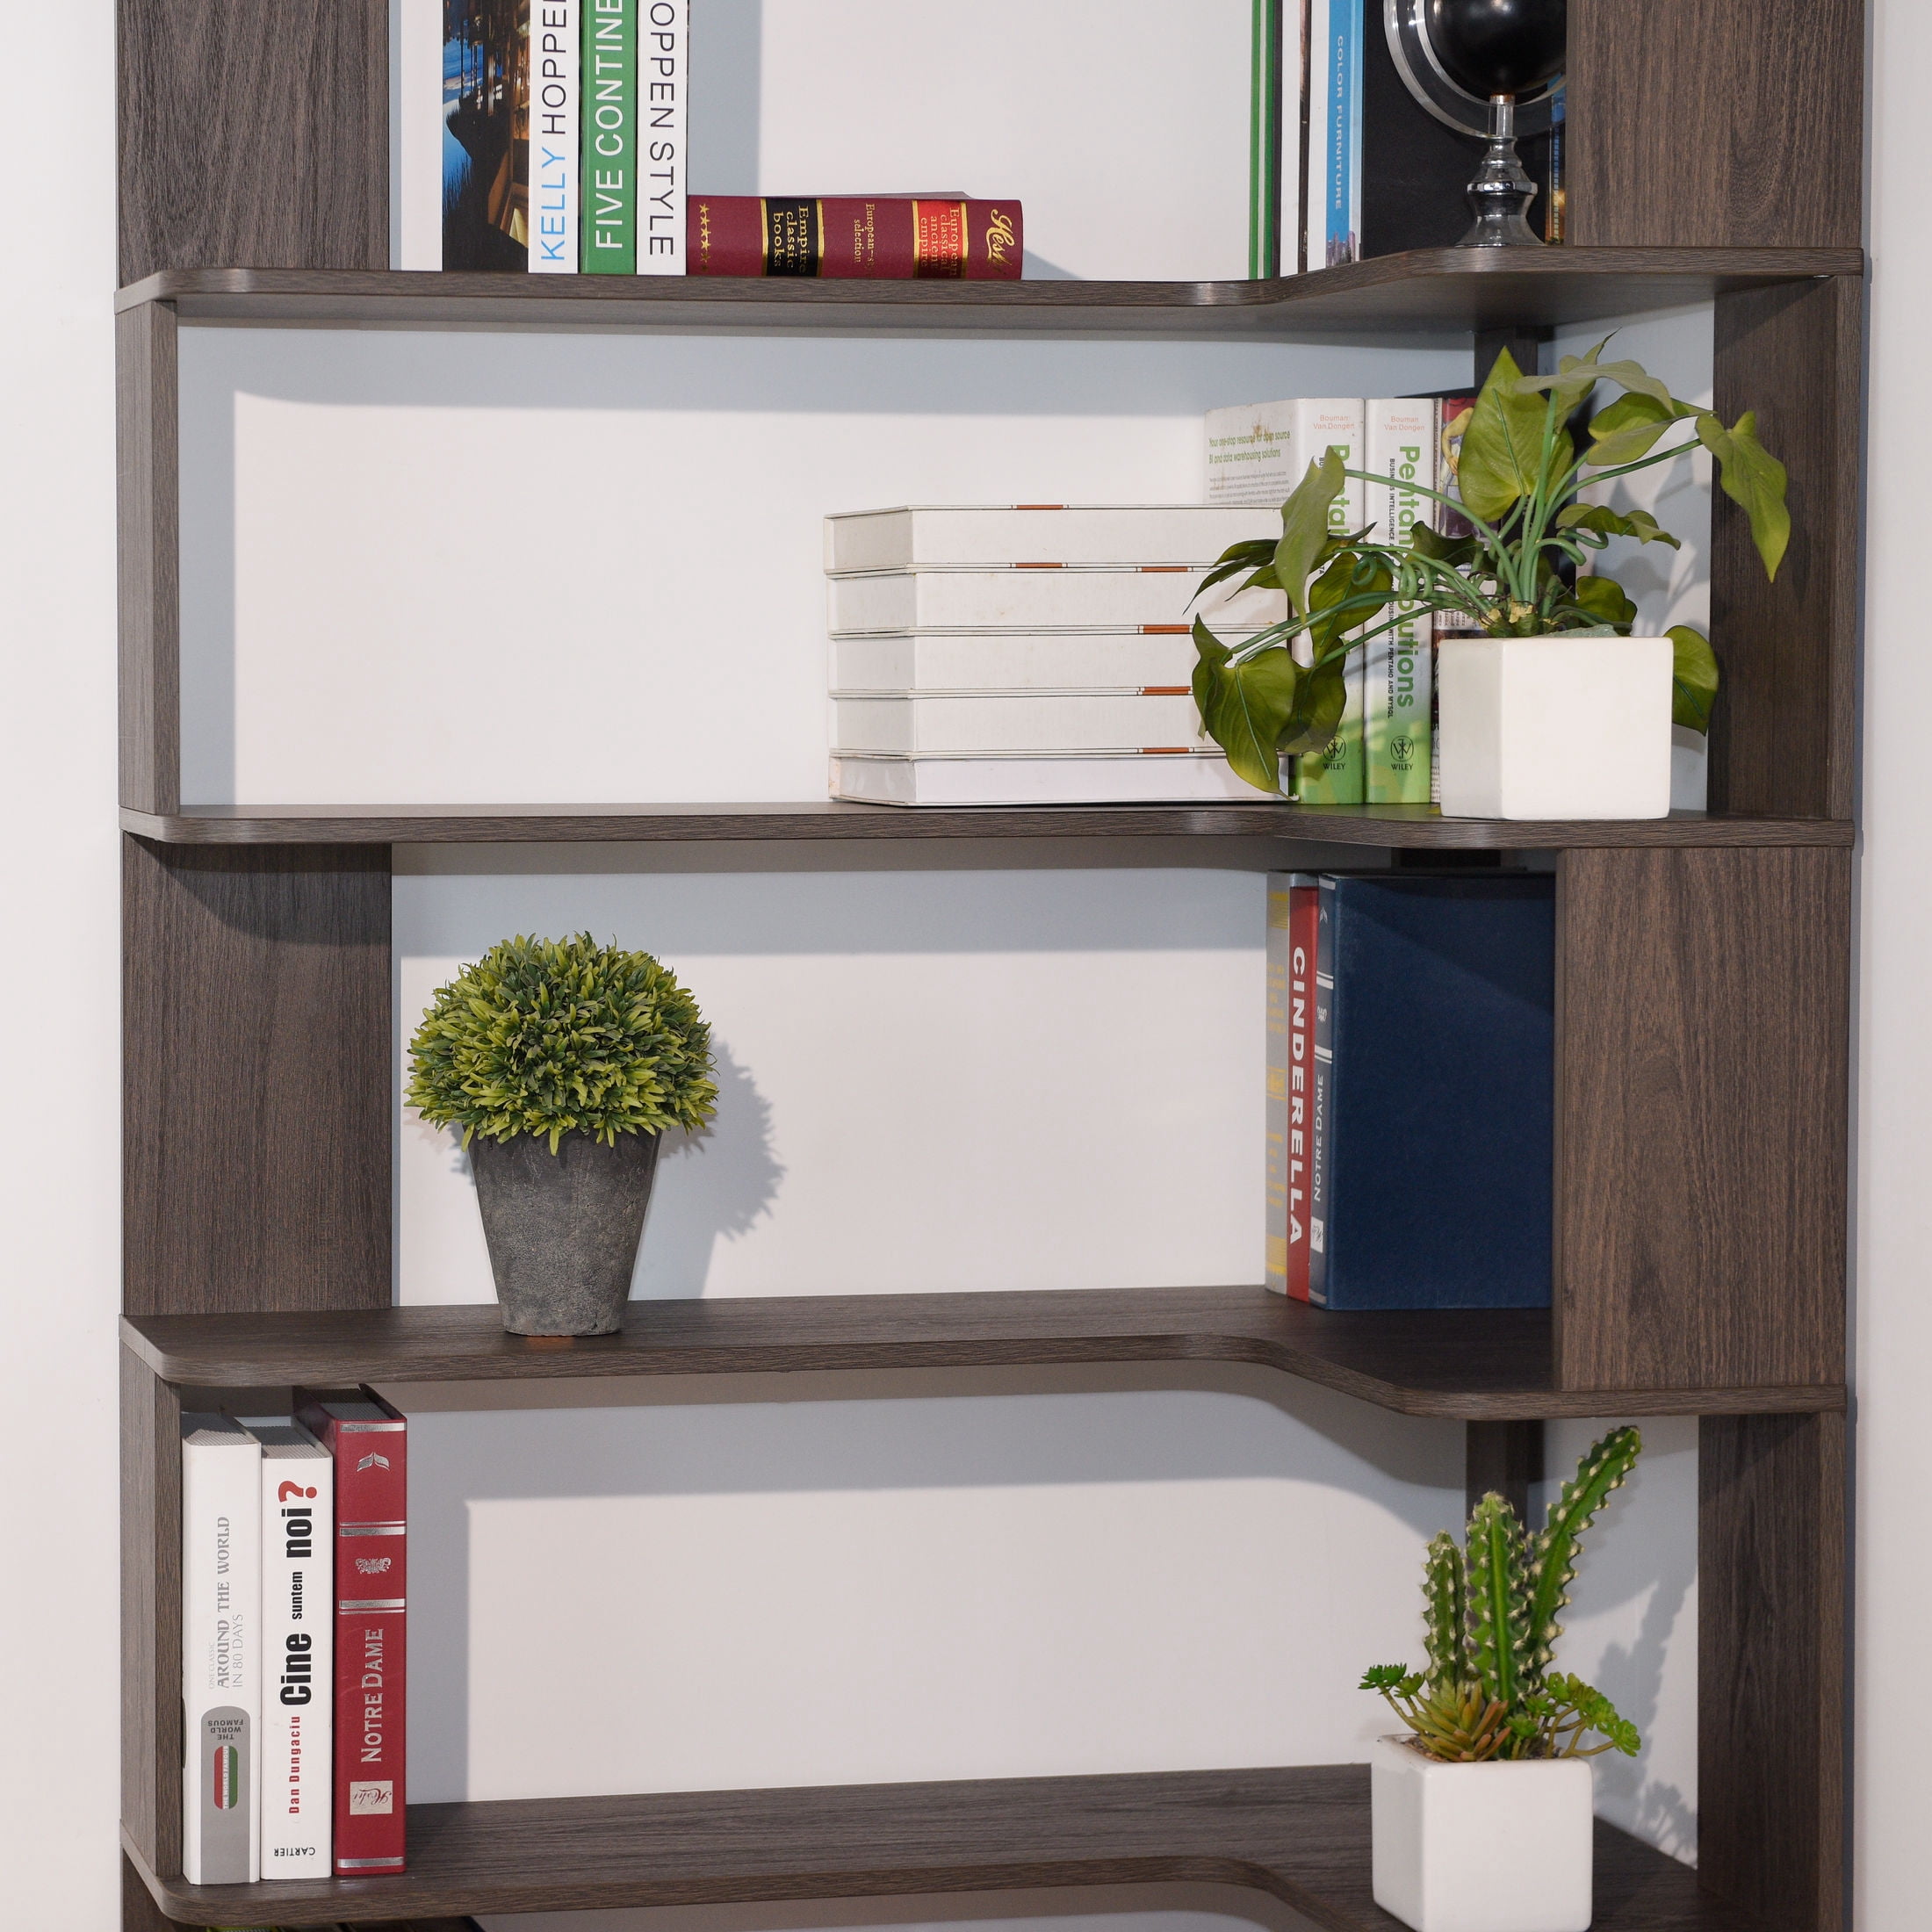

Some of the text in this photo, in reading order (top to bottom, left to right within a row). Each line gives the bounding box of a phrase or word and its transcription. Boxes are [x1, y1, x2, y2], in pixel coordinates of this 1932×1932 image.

[540, 0, 567, 261] KELLY HOPPE
[650, 2, 674, 256] OPPEN STYLE
[595, 169, 623, 249] FIVE
[773, 212, 785, 267] books
[786, 211, 798, 269] classic
[797, 205, 811, 273] Empire
[854, 219, 866, 263] selection
[919, 217, 928, 267] empire
[1328, 422, 1355, 431] Dongen
[1289, 947, 1306, 1244] CINDERELLA
[1316, 1074, 1324, 1130] DAME
[217, 1517, 230, 1689] AROUND THE WORLD
[278, 1480, 317, 1706] Cine suntem noi?
[232, 1614, 243, 1687] IN 80 DAYS
[361, 1628, 384, 1763] NOTRE DAME
[289, 1716, 301, 1813] Dan Dungaciu
[273, 1847, 315, 1857] CARTIER
